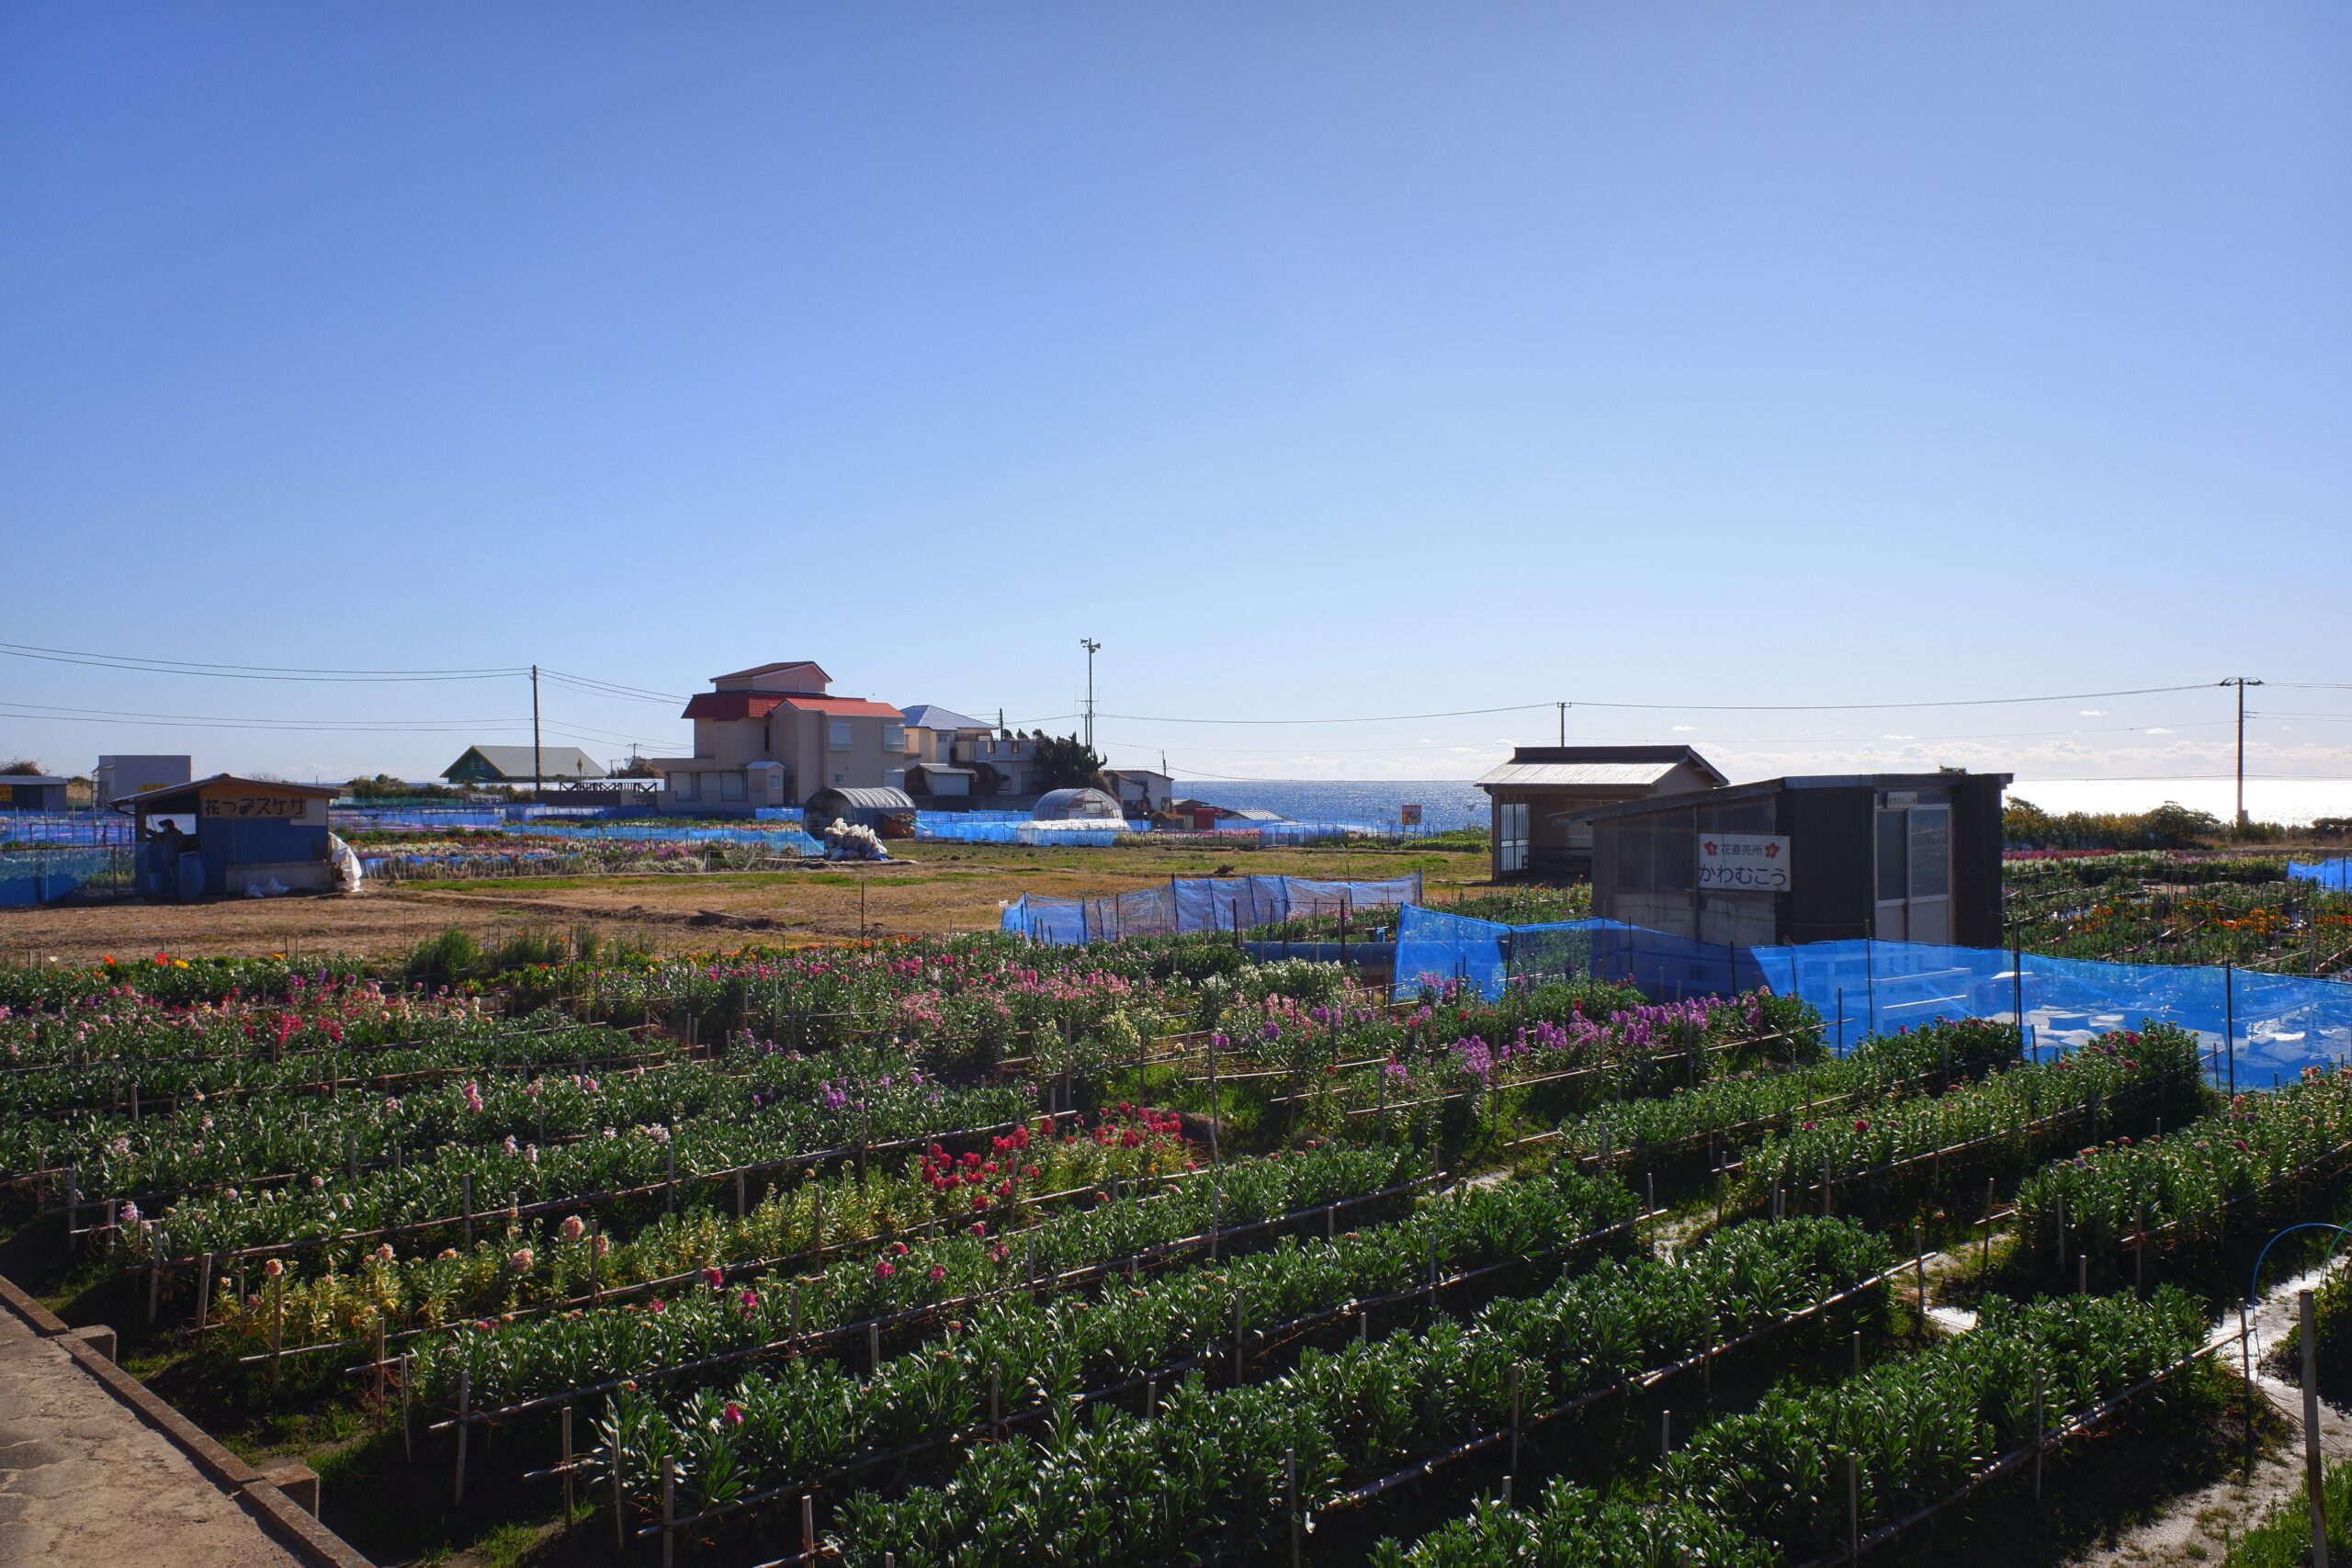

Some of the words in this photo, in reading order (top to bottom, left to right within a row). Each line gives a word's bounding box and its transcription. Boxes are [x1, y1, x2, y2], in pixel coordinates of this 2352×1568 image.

[1721, 843, 1763, 856] 花直売所
[1699, 864, 1787, 886] かわむこう
